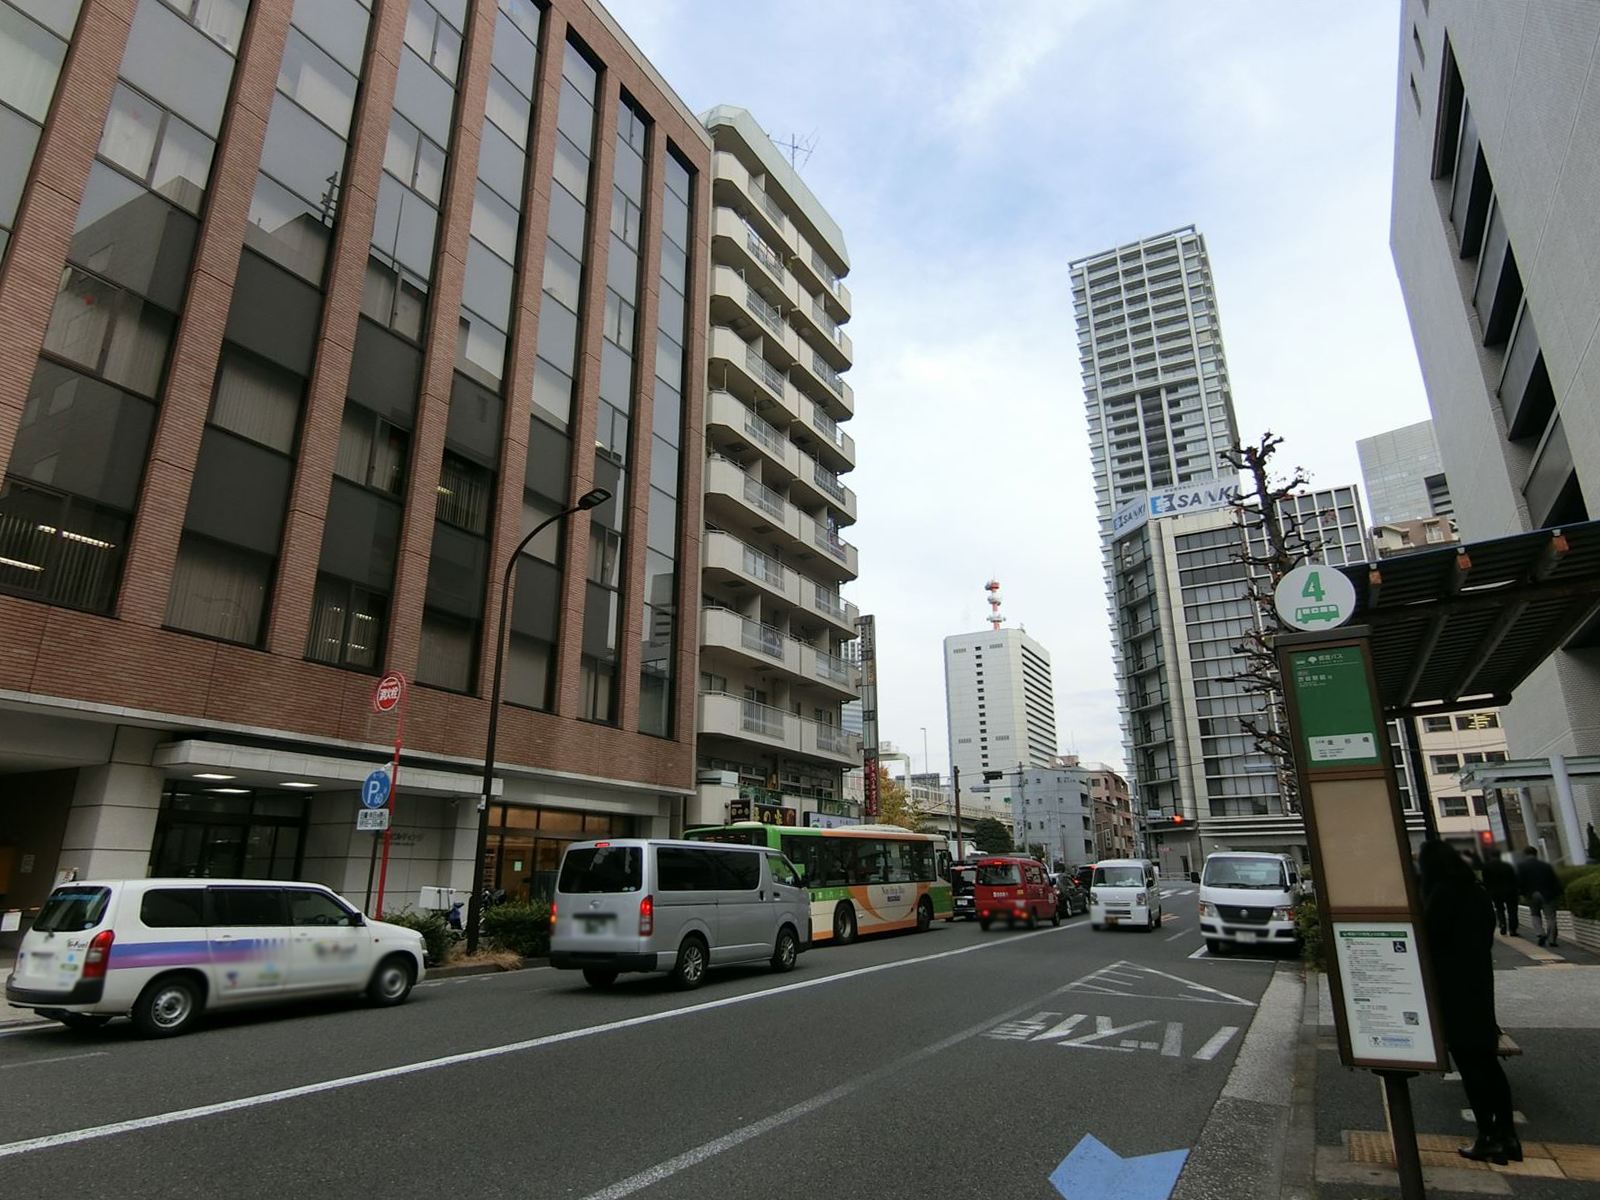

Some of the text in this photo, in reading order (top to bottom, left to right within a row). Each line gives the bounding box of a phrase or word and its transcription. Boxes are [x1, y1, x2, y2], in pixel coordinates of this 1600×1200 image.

[1177, 484, 1239, 508] SANKI
[1302, 571, 1326, 602] 4
[367, 780, 381, 804] P
